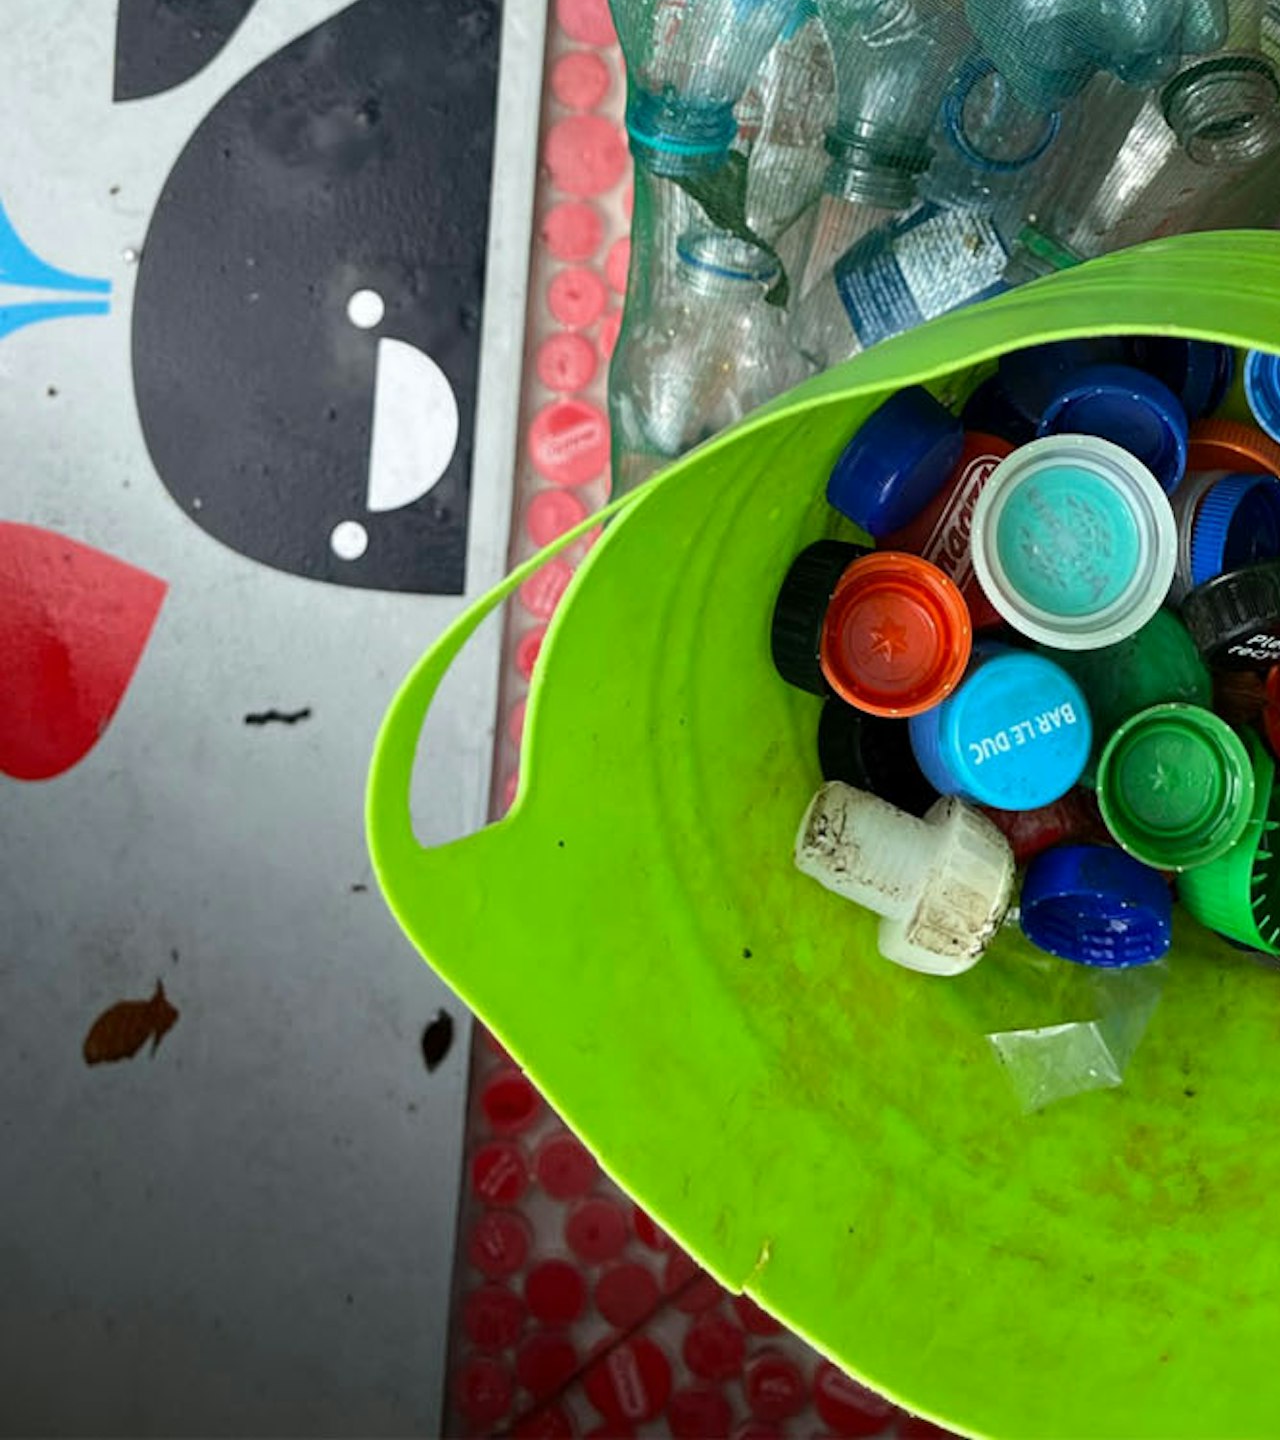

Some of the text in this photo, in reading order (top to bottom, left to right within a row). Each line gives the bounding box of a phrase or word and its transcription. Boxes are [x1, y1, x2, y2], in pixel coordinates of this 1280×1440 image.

[970, 703, 1077, 765] BAR LE DUC
